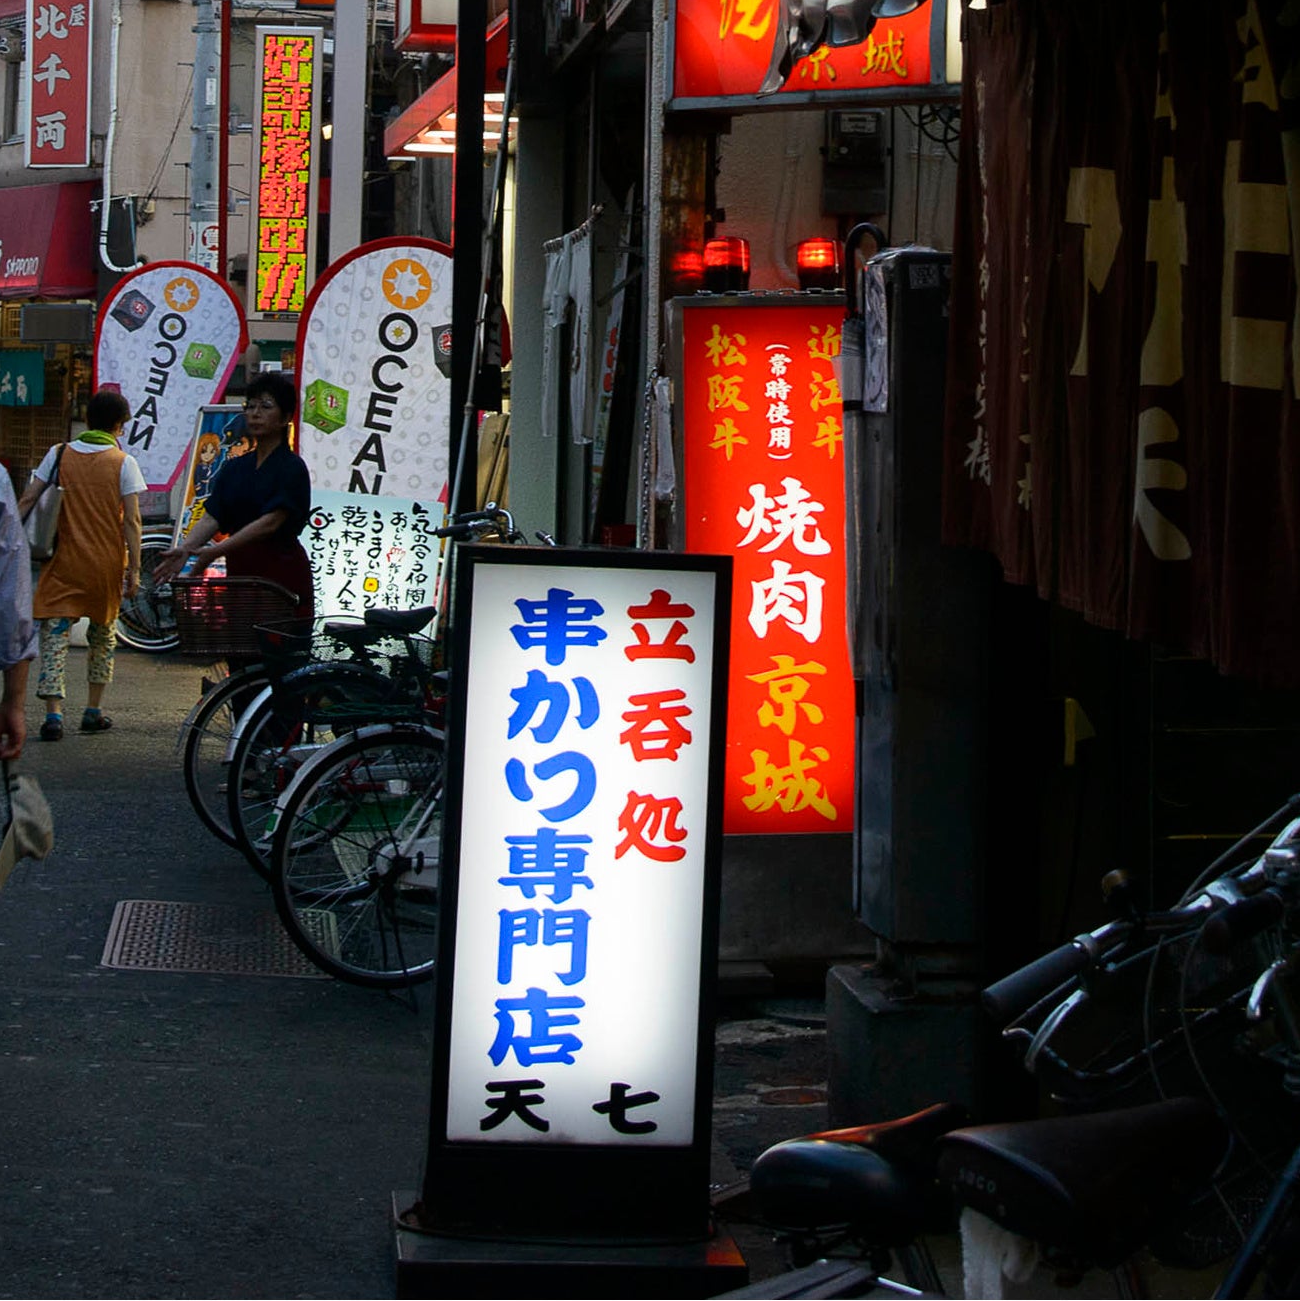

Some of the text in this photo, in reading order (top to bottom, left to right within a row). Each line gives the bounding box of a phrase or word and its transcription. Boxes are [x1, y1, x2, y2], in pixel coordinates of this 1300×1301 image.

[349, 312, 419, 496] OCEAN
[703, 324, 750, 461] 松阪牛
[764, 343, 794, 461] (常時使用)
[612, 587, 698, 863] 立呑処
[487, 587, 609, 1069] 串かつ専門店
[478, 1077, 661, 1136] 天七
